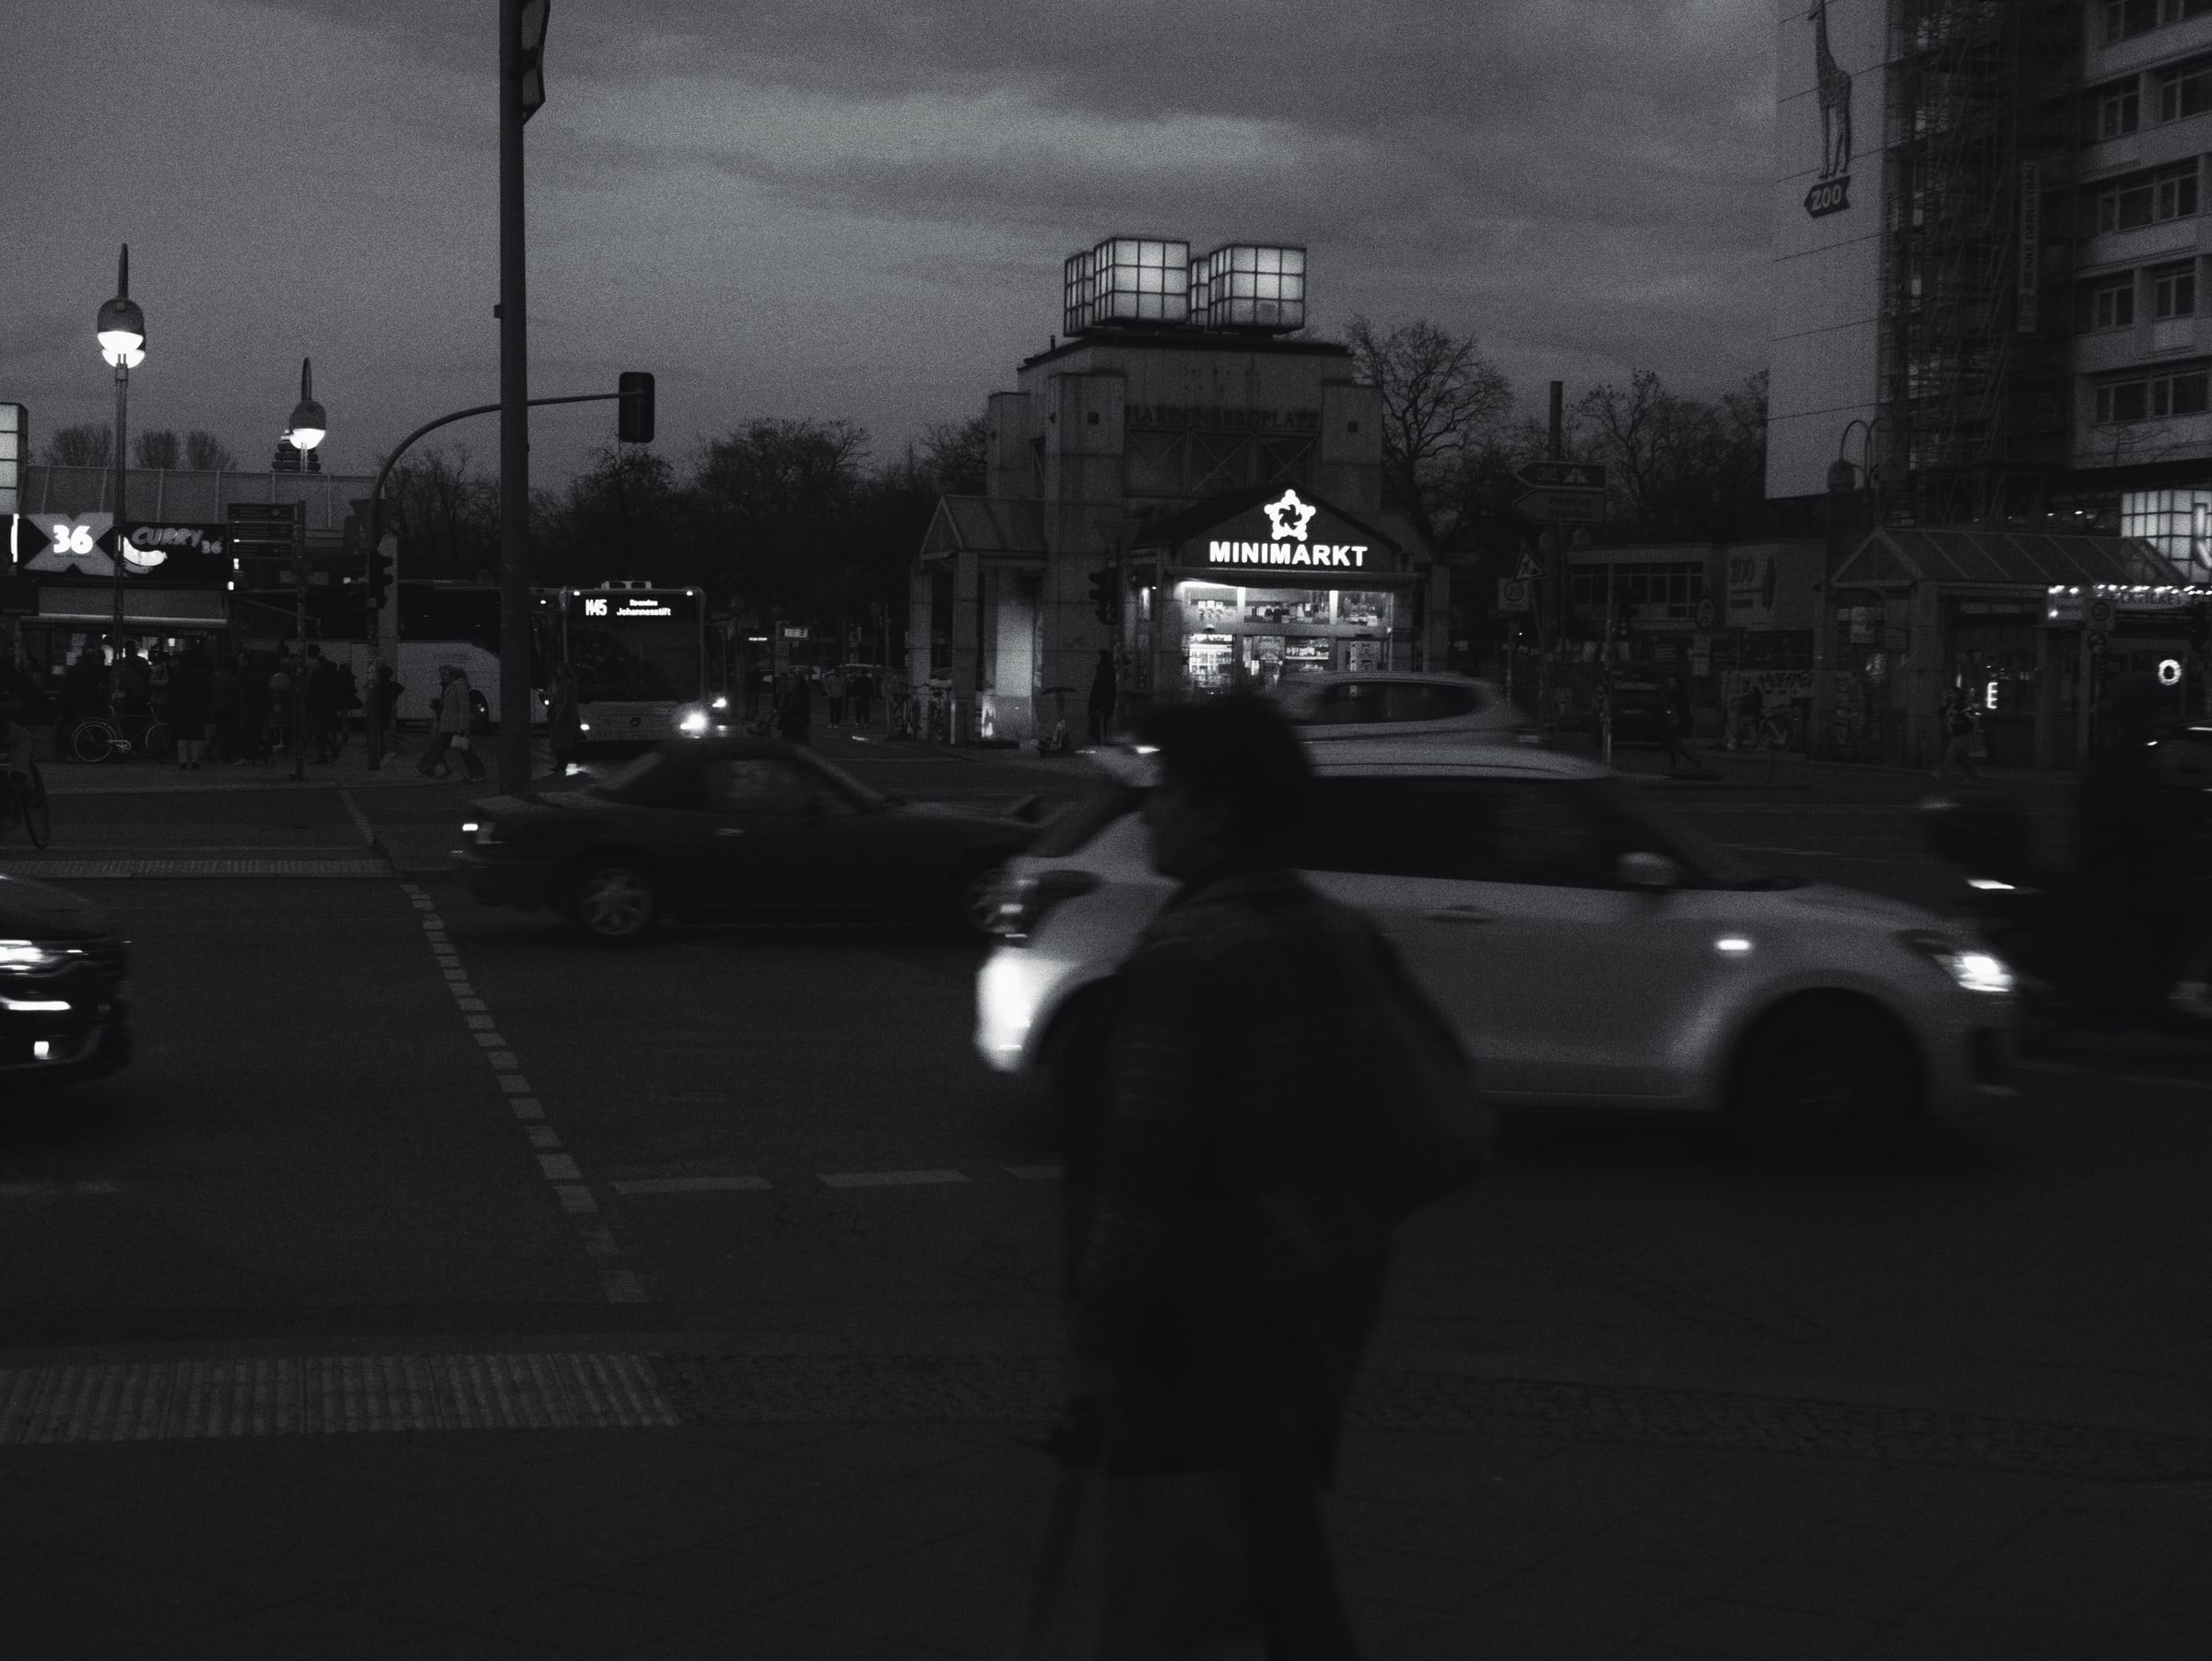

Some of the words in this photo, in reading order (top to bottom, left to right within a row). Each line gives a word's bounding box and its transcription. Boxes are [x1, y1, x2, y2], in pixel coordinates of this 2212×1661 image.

[1810, 183, 1842, 212] ZOO
[53, 524, 94, 555] 36
[131, 525, 205, 548] CURRY
[200, 540, 223, 555] 36
[1209, 540, 1369, 567] MINIMARKT
